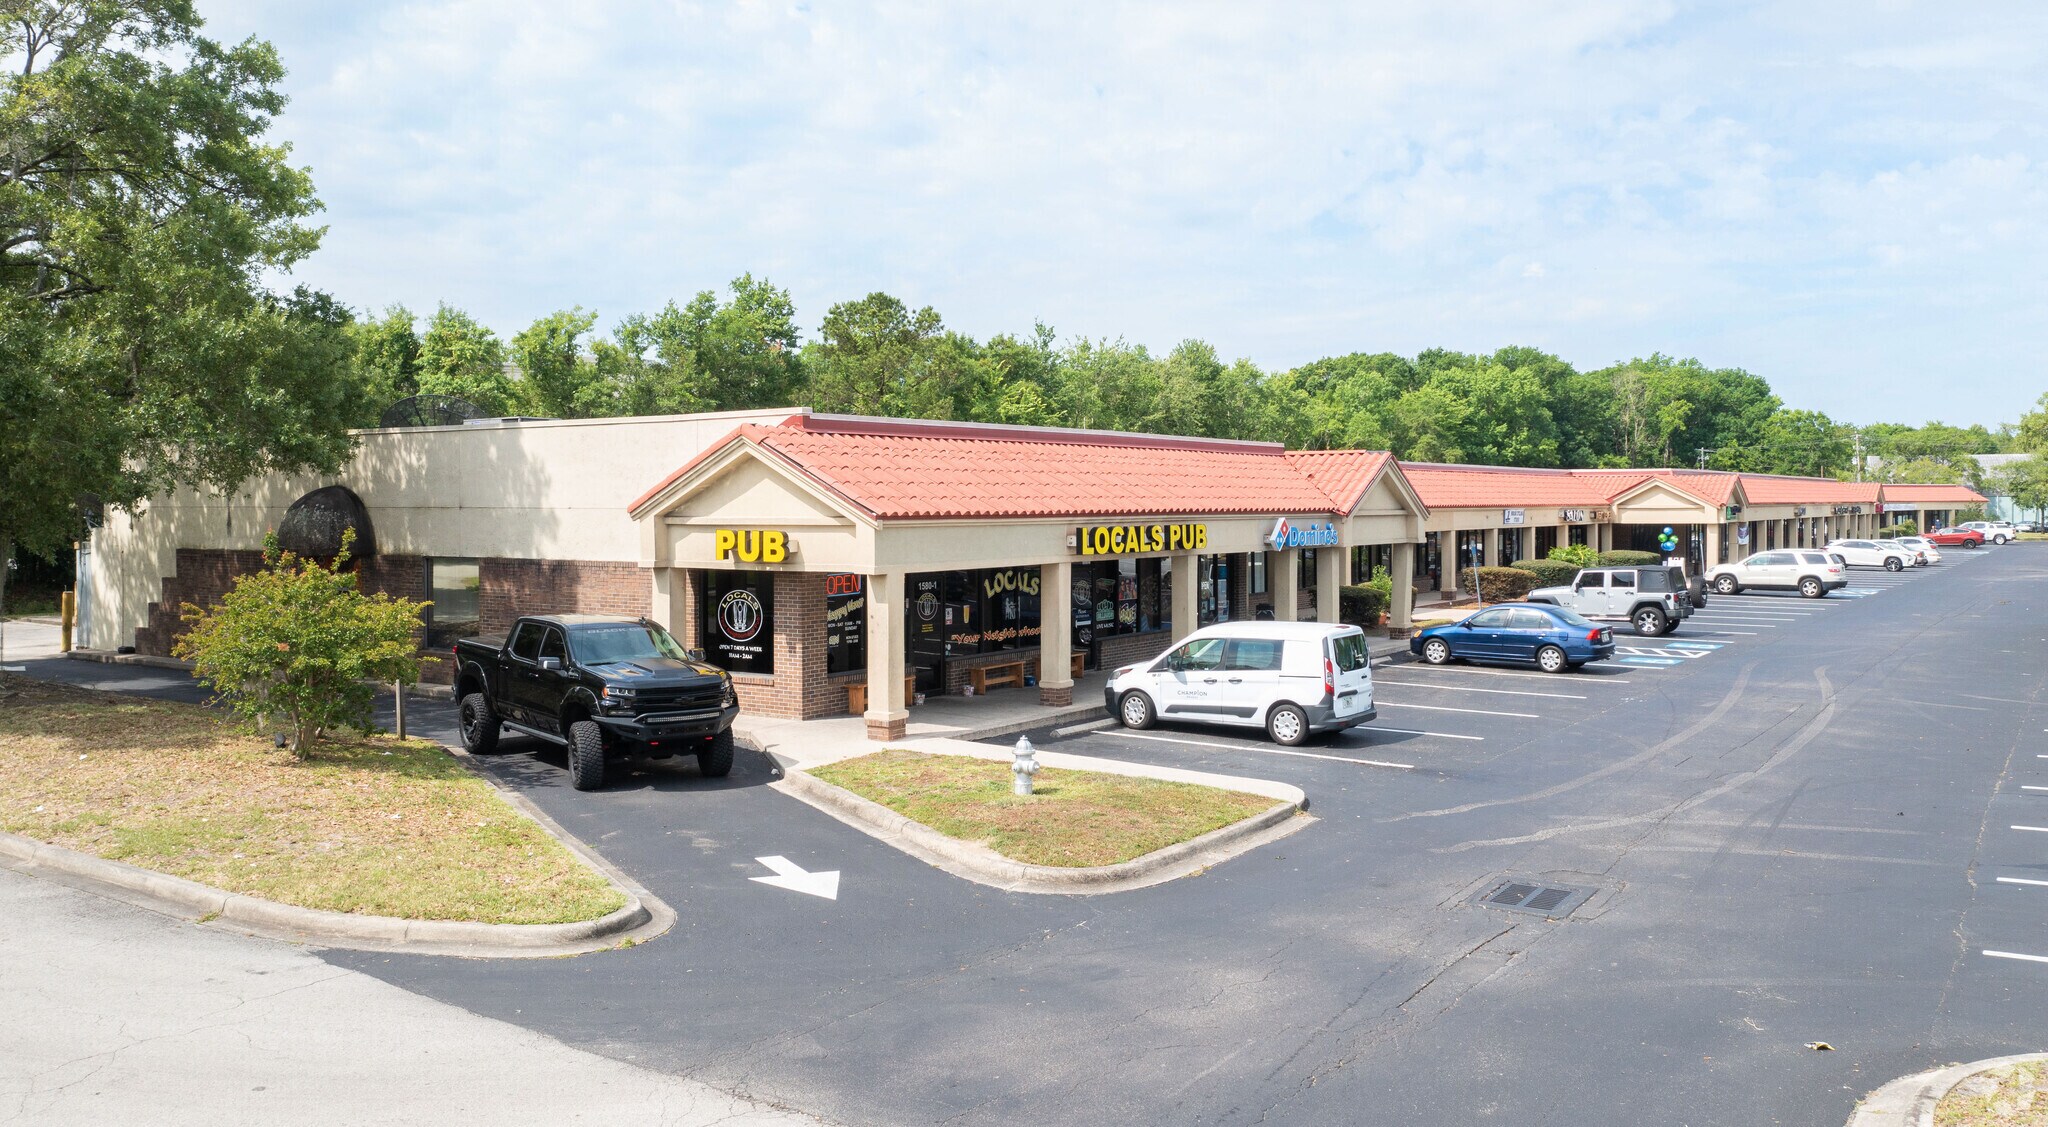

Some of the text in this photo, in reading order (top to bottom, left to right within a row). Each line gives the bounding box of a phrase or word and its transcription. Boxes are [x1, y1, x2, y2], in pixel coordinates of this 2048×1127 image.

[716, 529, 785, 562] PUB
[1083, 524, 1207, 554] LOCALS PUB
[1289, 522, 1338, 547] Domino's
[827, 575, 859, 595] OPEN
[918, 581, 937, 590] 1580-1
[984, 570, 1040, 599] LOCALS
[722, 592, 759, 610] LOCALS
